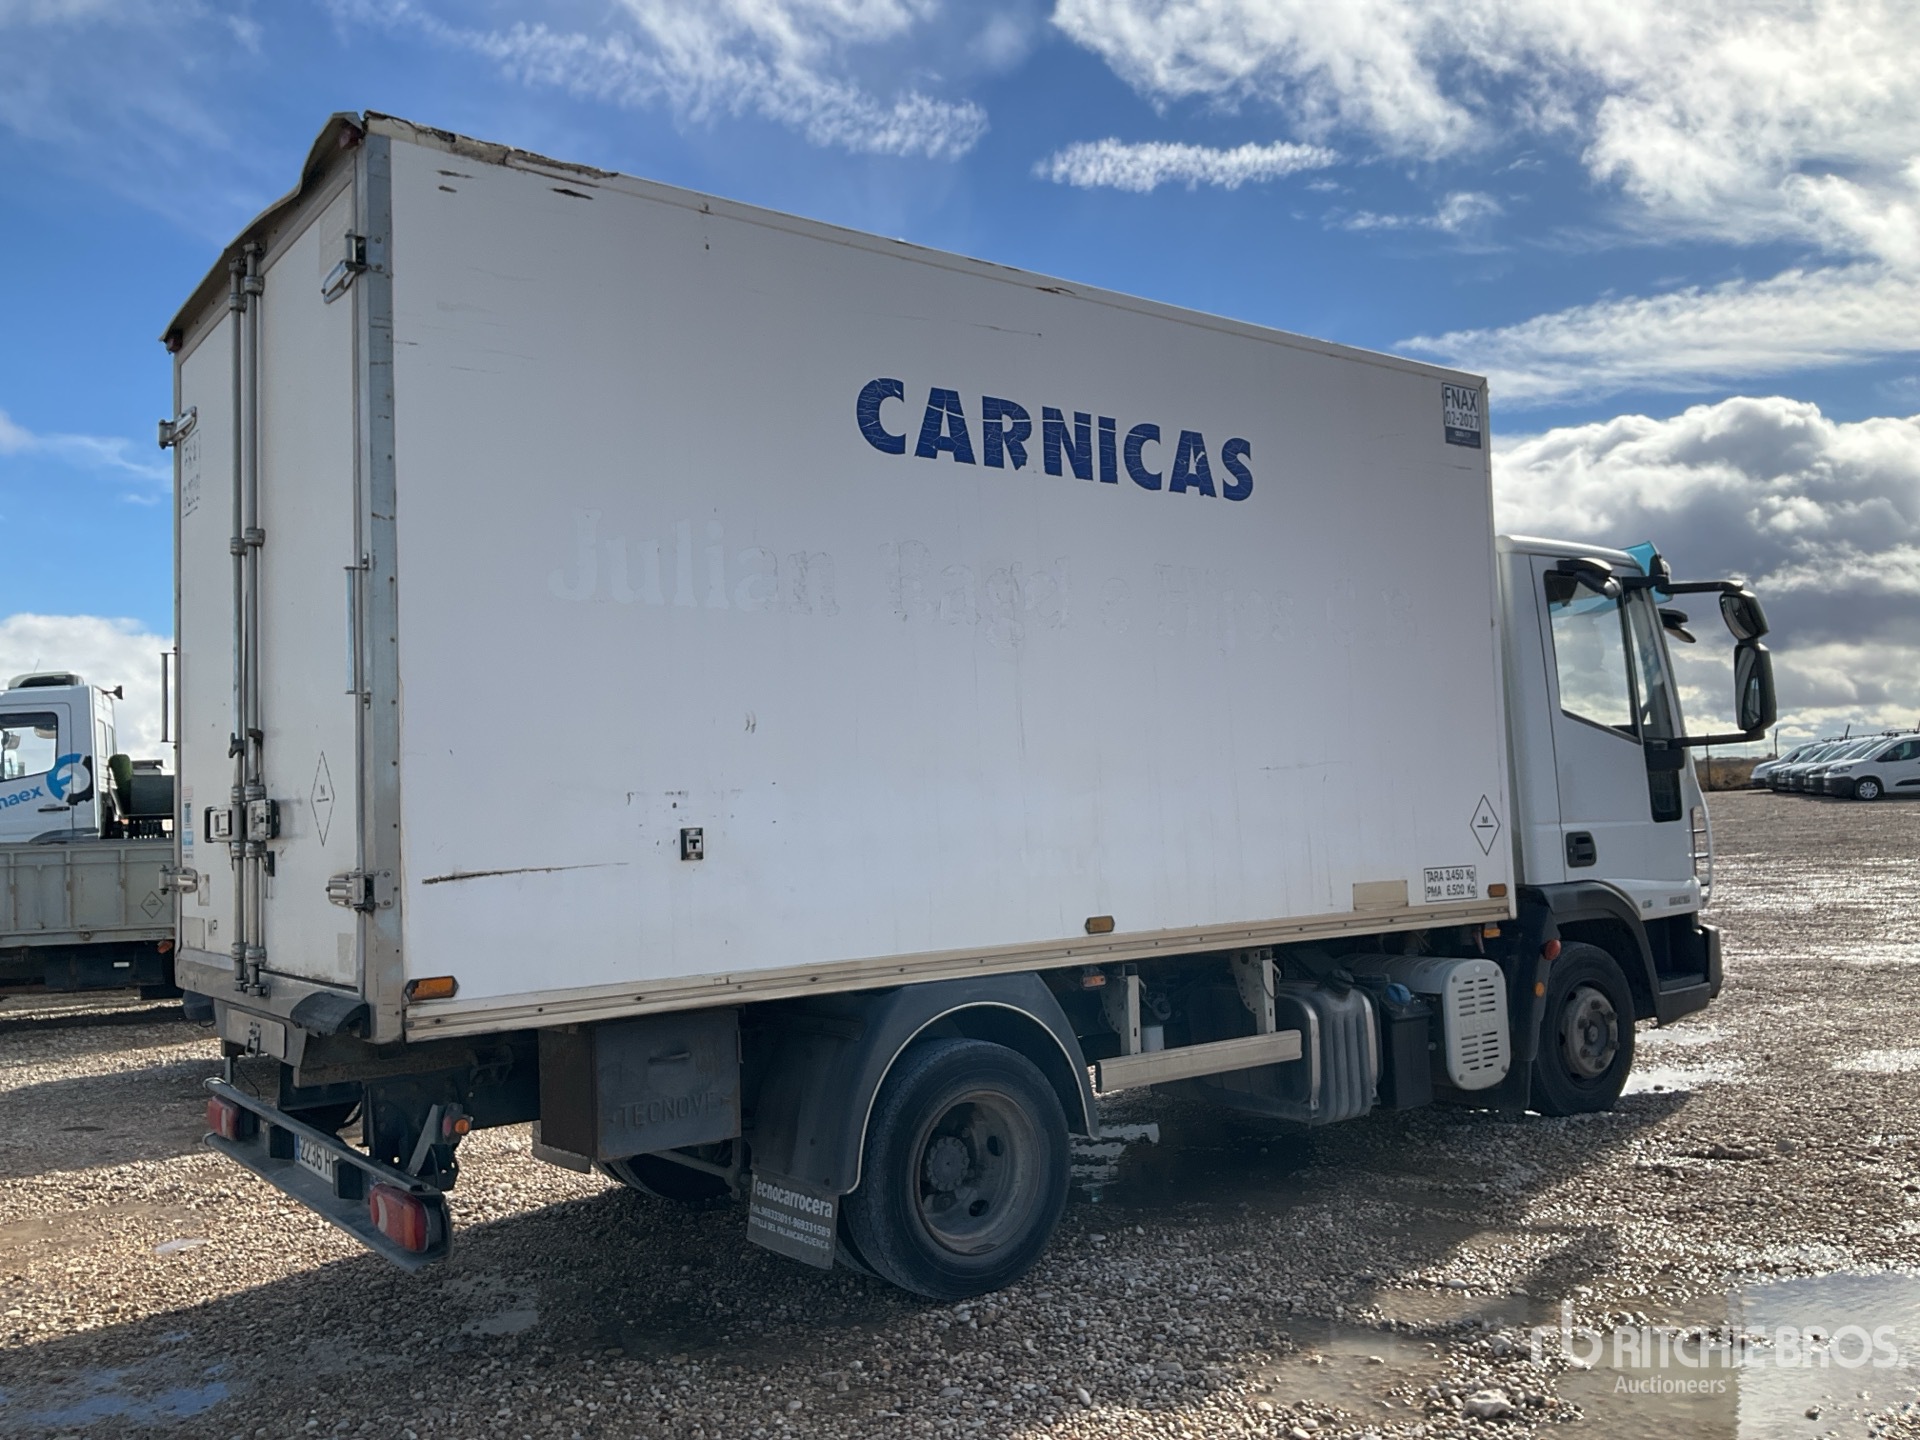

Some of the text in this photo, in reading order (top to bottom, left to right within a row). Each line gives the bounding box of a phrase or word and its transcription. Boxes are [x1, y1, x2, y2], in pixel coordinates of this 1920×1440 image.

[1444, 386, 1478, 413] FNAX
[856, 377, 1254, 502] CARNICAS
[1426, 868, 1475, 883] TARA 3.450 Kg
[1426, 885, 1443, 898] PMA
[1446, 883, 1465, 896] 6.500
[751, 1174, 833, 1218] Tecnocarrocera
